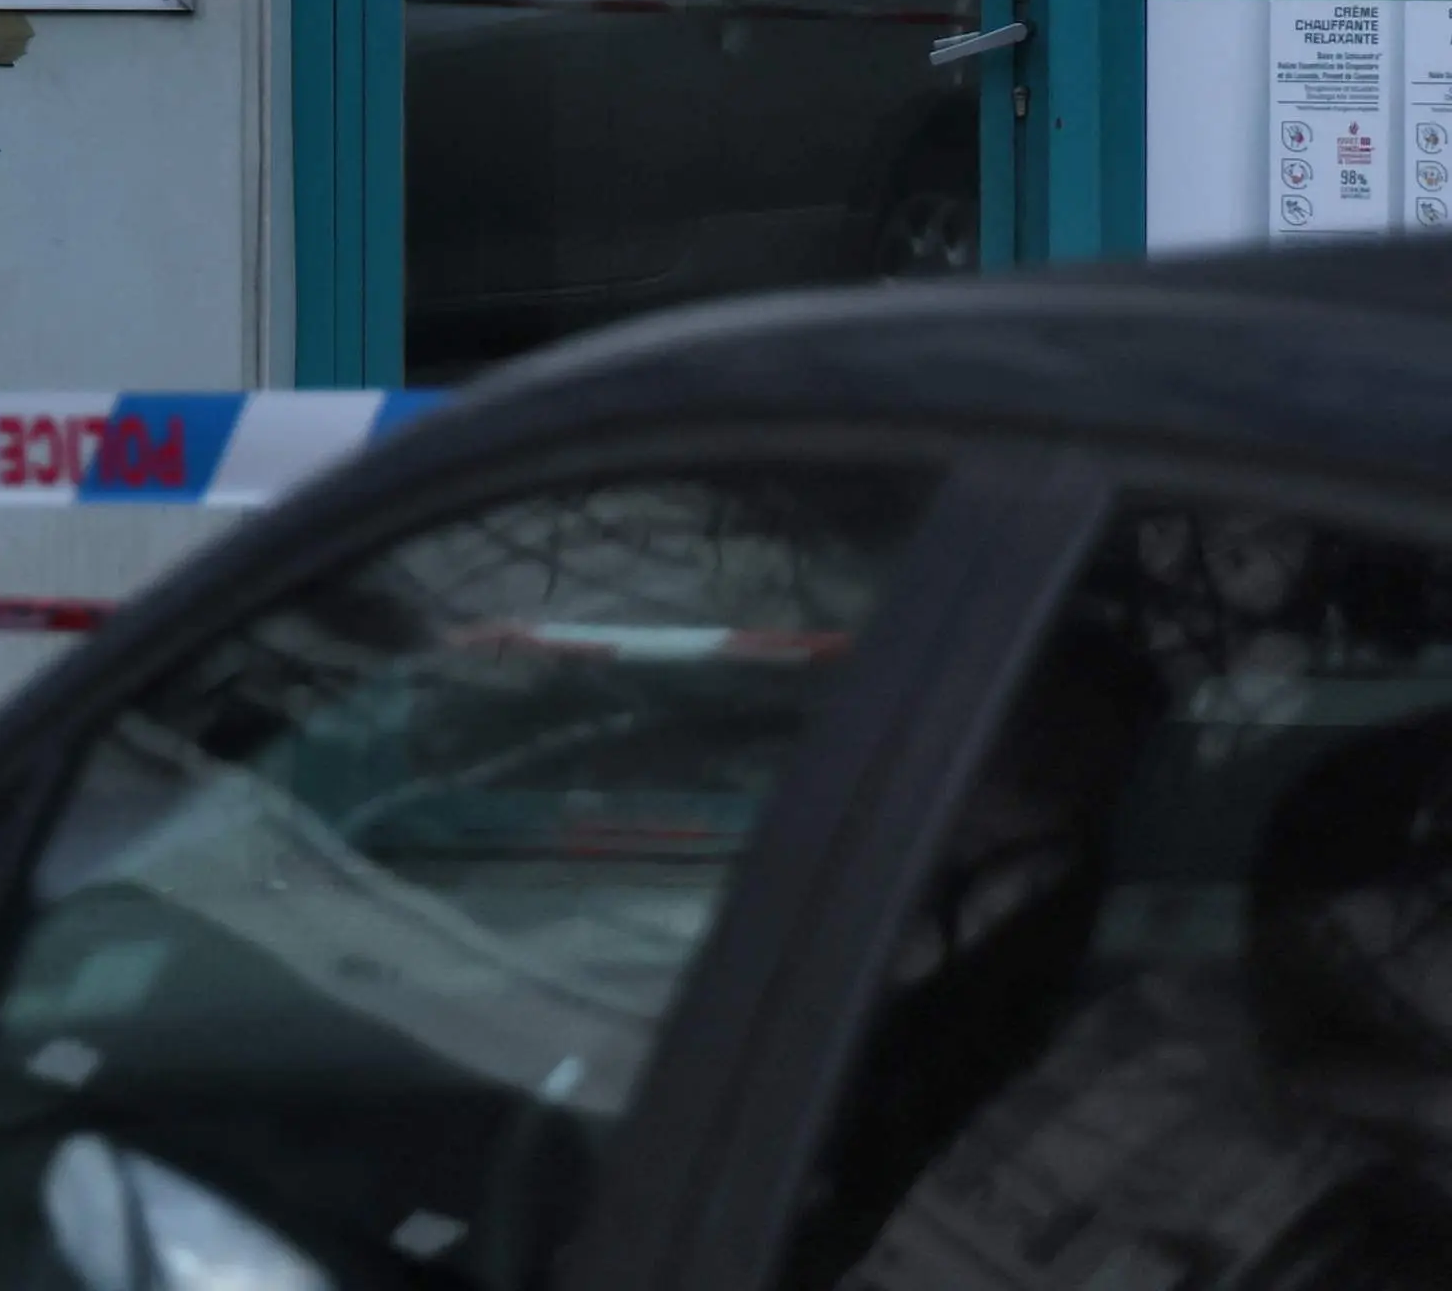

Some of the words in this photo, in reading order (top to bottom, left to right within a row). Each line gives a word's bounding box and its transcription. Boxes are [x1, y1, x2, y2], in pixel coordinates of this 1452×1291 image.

[1334, 4, 1379, 19] CRÈME
[1295, 19, 1379, 32] CHAUFFANTE
[1304, 32, 1379, 45] RELAXANTE
[1340, 169, 1368, 186] 98%
